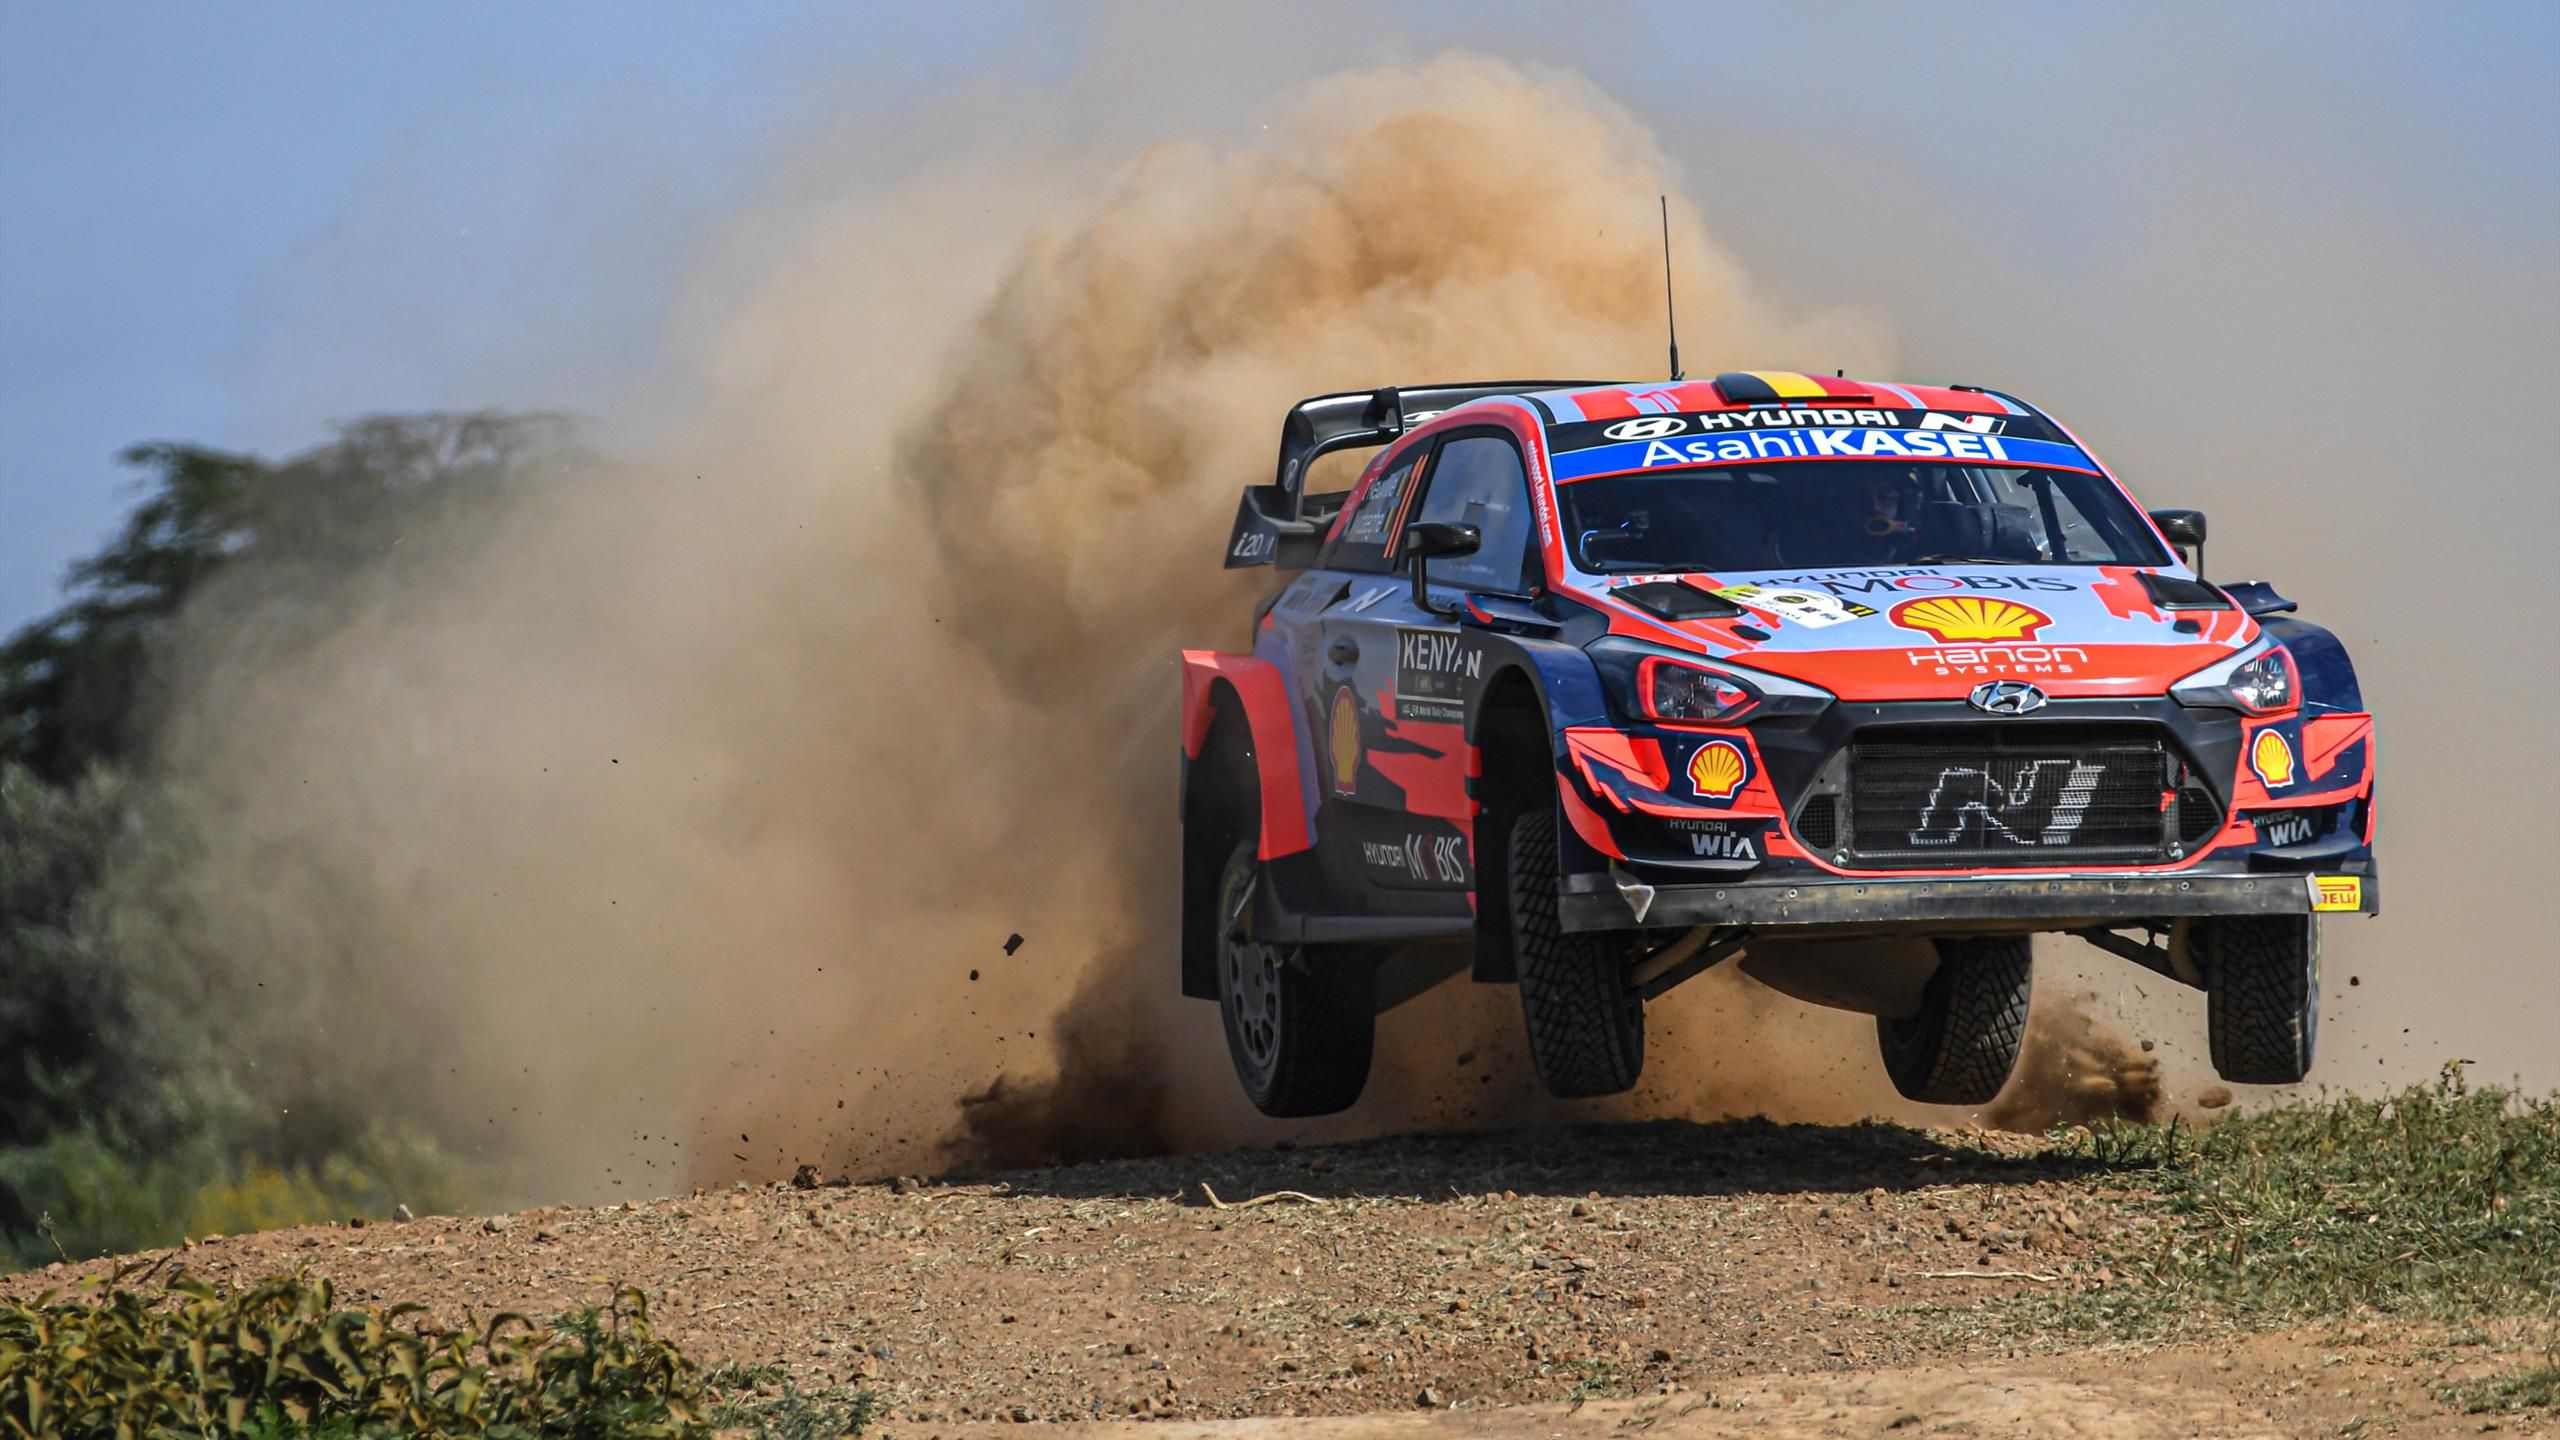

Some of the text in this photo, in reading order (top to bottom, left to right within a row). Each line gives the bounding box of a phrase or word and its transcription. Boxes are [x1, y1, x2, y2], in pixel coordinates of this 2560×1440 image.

[1699, 410, 1900, 430] HYUNDAI
[1750, 569, 1942, 587] HYUNDAI
[1817, 575, 2078, 596] MOBIS
[1935, 664, 2074, 675] SYSTEMS
[1669, 819, 1727, 832] HYUNDAI
[1363, 834, 1464, 883] HYUNDAI MOBIS
